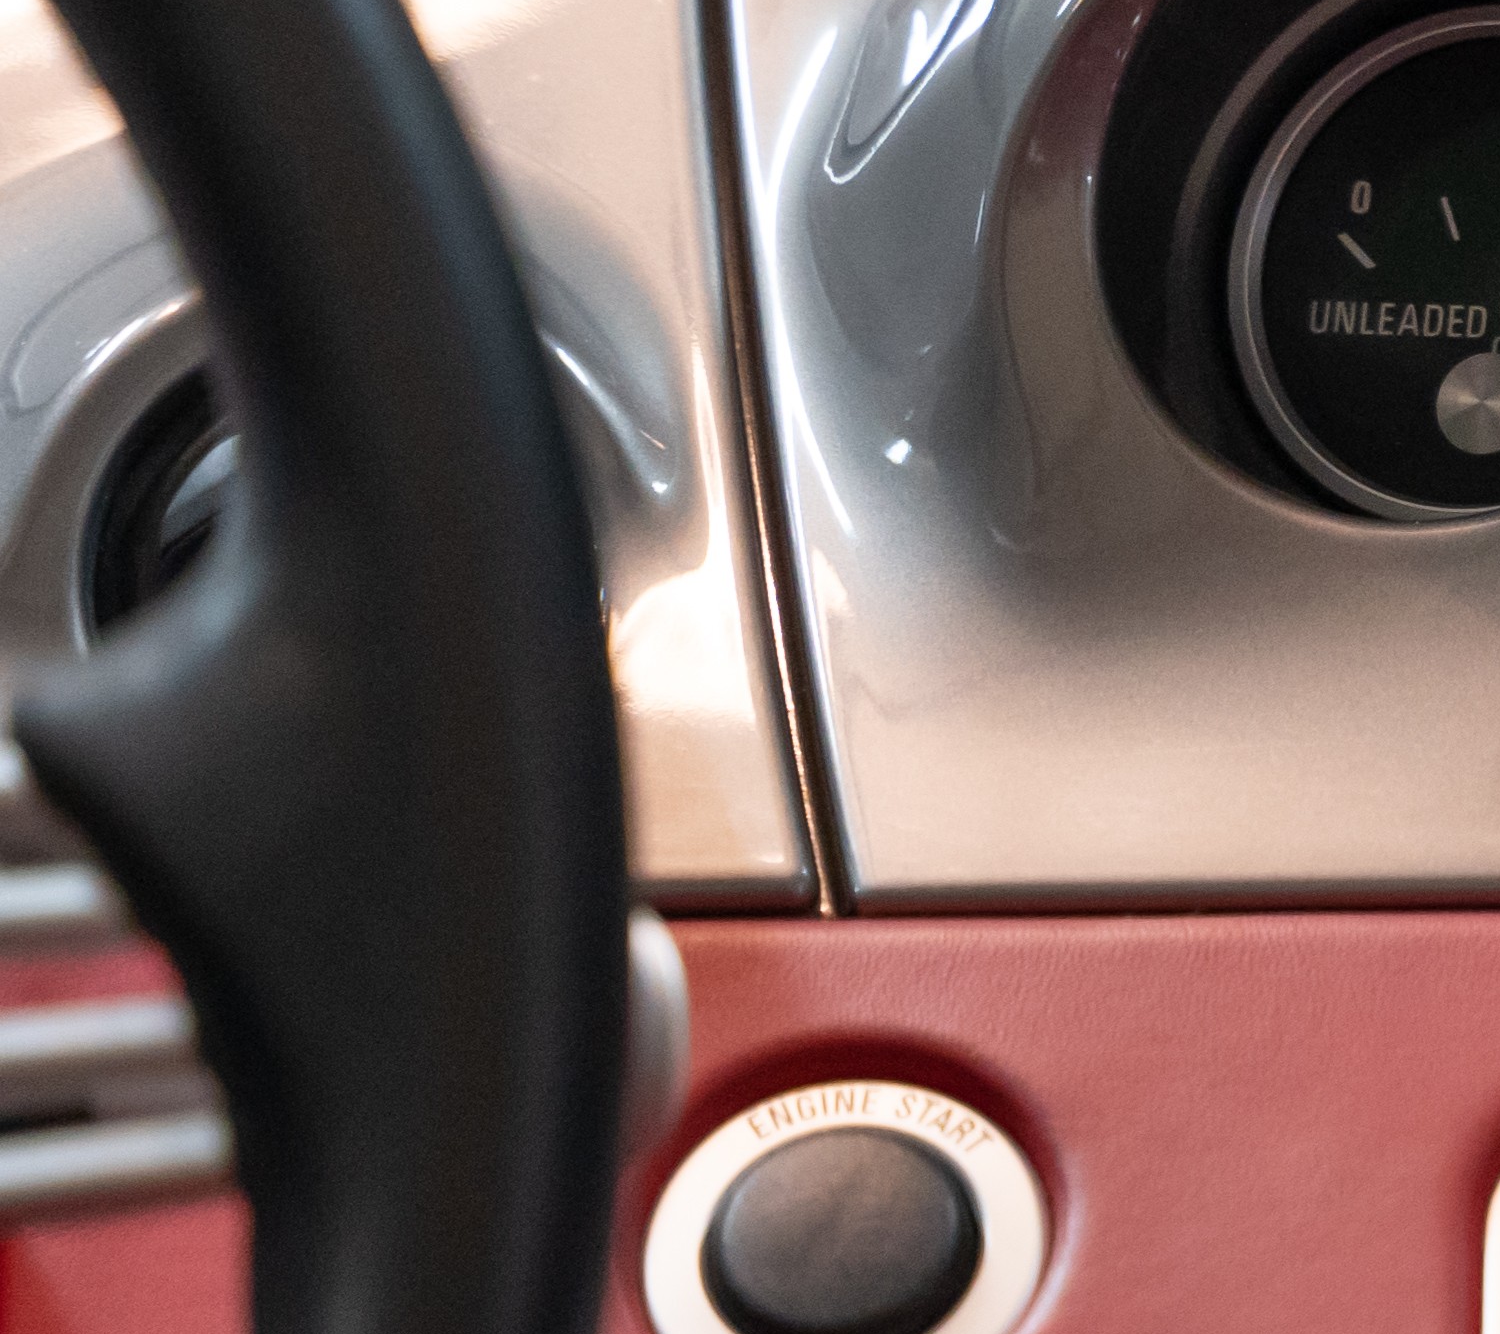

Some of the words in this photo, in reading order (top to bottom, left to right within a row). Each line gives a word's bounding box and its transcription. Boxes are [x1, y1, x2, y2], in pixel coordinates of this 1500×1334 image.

[1351, 181, 1372, 214] 0
[1309, 301, 1488, 339] UNLEADED
[747, 1088, 879, 1140] ENGINE
[895, 1093, 995, 1153] START
